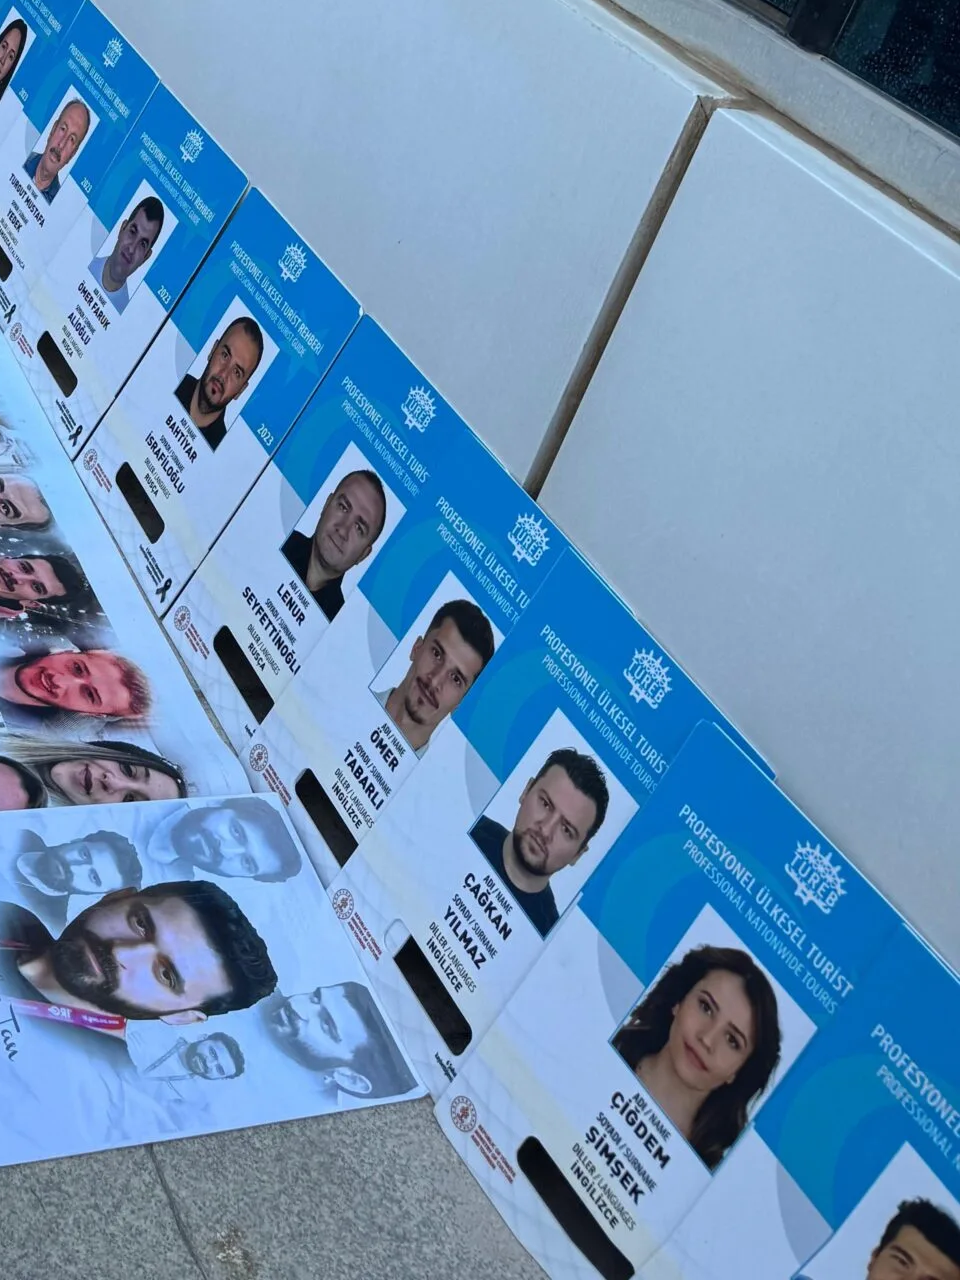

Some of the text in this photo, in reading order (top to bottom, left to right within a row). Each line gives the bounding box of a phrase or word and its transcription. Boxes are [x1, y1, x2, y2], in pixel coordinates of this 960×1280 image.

[6, 209, 22, 231] YEDEK
[8, 173, 26, 199] TURGUT
[23, 195, 46, 226] MUSTAFA
[77, 280, 110, 330] ÖMER FARUK
[157, 285, 171, 304] 2023
[230, 240, 324, 355] PROFESYONEL ÜLKESEL TURİST REHBERİ
[66, 310, 91, 345] ALİOĞLU
[164, 413, 199, 462] BAHTİYAR
[258, 425, 273, 446] 2023
[341, 375, 431, 486] PROFESYONEL ÜLKESEL TURİS
[405, 397, 430, 427] TUREB
[143, 430, 188, 494] İSRAFİLOĞLU
[341, 398, 420, 497] PROFESSIONAL NATIONWIDE TOURI
[143, 473, 159, 497] RUSÇA
[435, 496, 486, 559] PROFESYONEL
[483, 550, 519, 596] ÜLKESEL
[436, 522, 478, 574] PROFESSIONAL
[475, 569, 513, 616] NATIONWIDE
[512, 524, 543, 560] TUREB
[264, 598, 295, 645] SOYADI SURNAME
[277, 584, 305, 625] LENUR
[296, 590, 310, 610] NAME
[246, 642, 266, 671] RUSÇA
[259, 643, 280, 675] LANGUAGES
[540, 623, 600, 697] PROFESYONEL
[597, 688, 639, 741] ÜLKESEL
[627, 658, 664, 703] TUREB
[369, 727, 400, 771] ÖMER
[380, 721, 405, 756] ADI NAME
[541, 654, 657, 794] PROFESSIONAL NATIONWIDE TOURIS
[334, 767, 374, 828] DİLLER LANGUAGES
[342, 749, 384, 809] TABARLI
[354, 741, 390, 796] SOYADI SURNAME
[331, 781, 363, 829] İNGİLİZCE
[461, 869, 514, 941] ÇAĞKAN
[482, 873, 512, 914] ADI NAME
[679, 801, 853, 997] PROFESYONEL ÜLKESEL TURİST
[789, 849, 838, 909] TUREB
[441, 906, 486, 969] YILMAZ
[451, 893, 497, 958] SOYADI SURNAME
[683, 838, 838, 1014] PROFESSIONAL NATIONWIDE TOURIS
[424, 936, 465, 992] İNGİLİZCE
[429, 920, 477, 993] DİLLER LANGUAGES
[608, 1086, 671, 1172] ÇİĞDEM
[633, 1092, 670, 1142] ADI NAME
[876, 1063, 953, 1157] PROFESSIONAL
[583, 1123, 644, 1207] ŞİMŞEK
[596, 1111, 656, 1192] SOYADI SURNAME
[570, 1159, 620, 1228] İNGİLİZCE
[572, 1142, 636, 1231] DİLLER LANGUAGES
